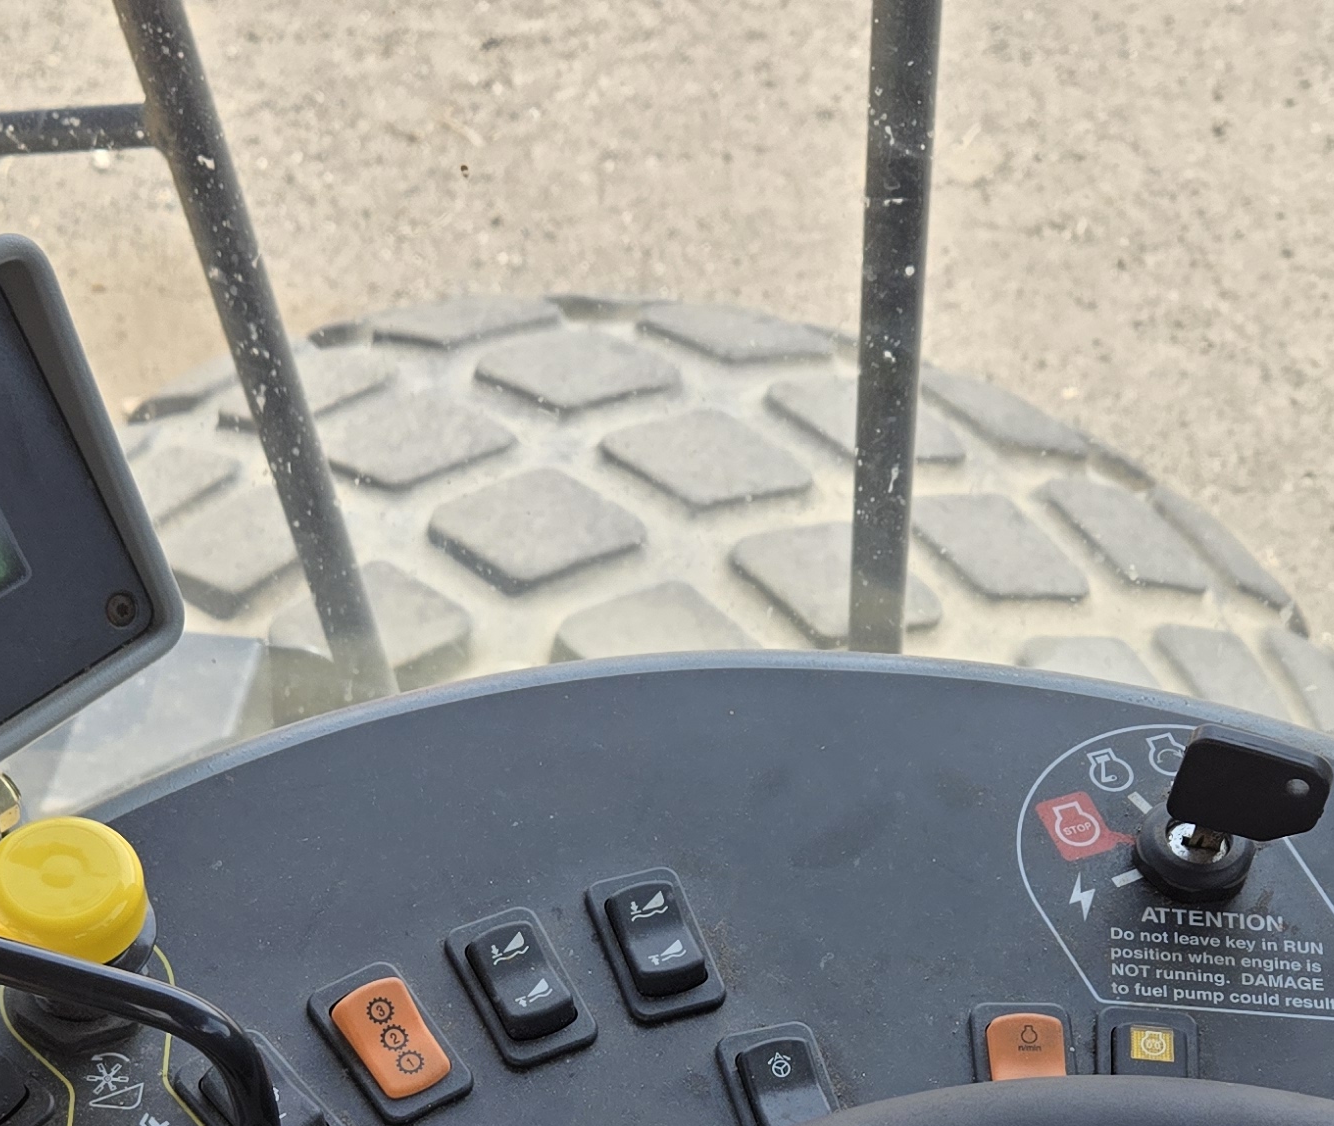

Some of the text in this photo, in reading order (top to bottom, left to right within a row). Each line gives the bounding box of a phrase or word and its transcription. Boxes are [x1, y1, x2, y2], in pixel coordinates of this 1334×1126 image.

[1063, 821, 1092, 836] STOP
[1141, 906, 1284, 932] ATTENTION
[1110, 927, 1324, 955] Do not leave key in RUN
[1111, 947, 1322, 972] position when engine is
[1111, 963, 1325, 991] NOT running. DAMAGE
[1111, 982, 1129, 995] to
[1134, 982, 1167, 998] fuel
[1173, 988, 1225, 1004] pump
[1230, 992, 1280, 1006] could
[375, 1004, 386, 1017] 3
[389, 1032, 400, 1045] 2
